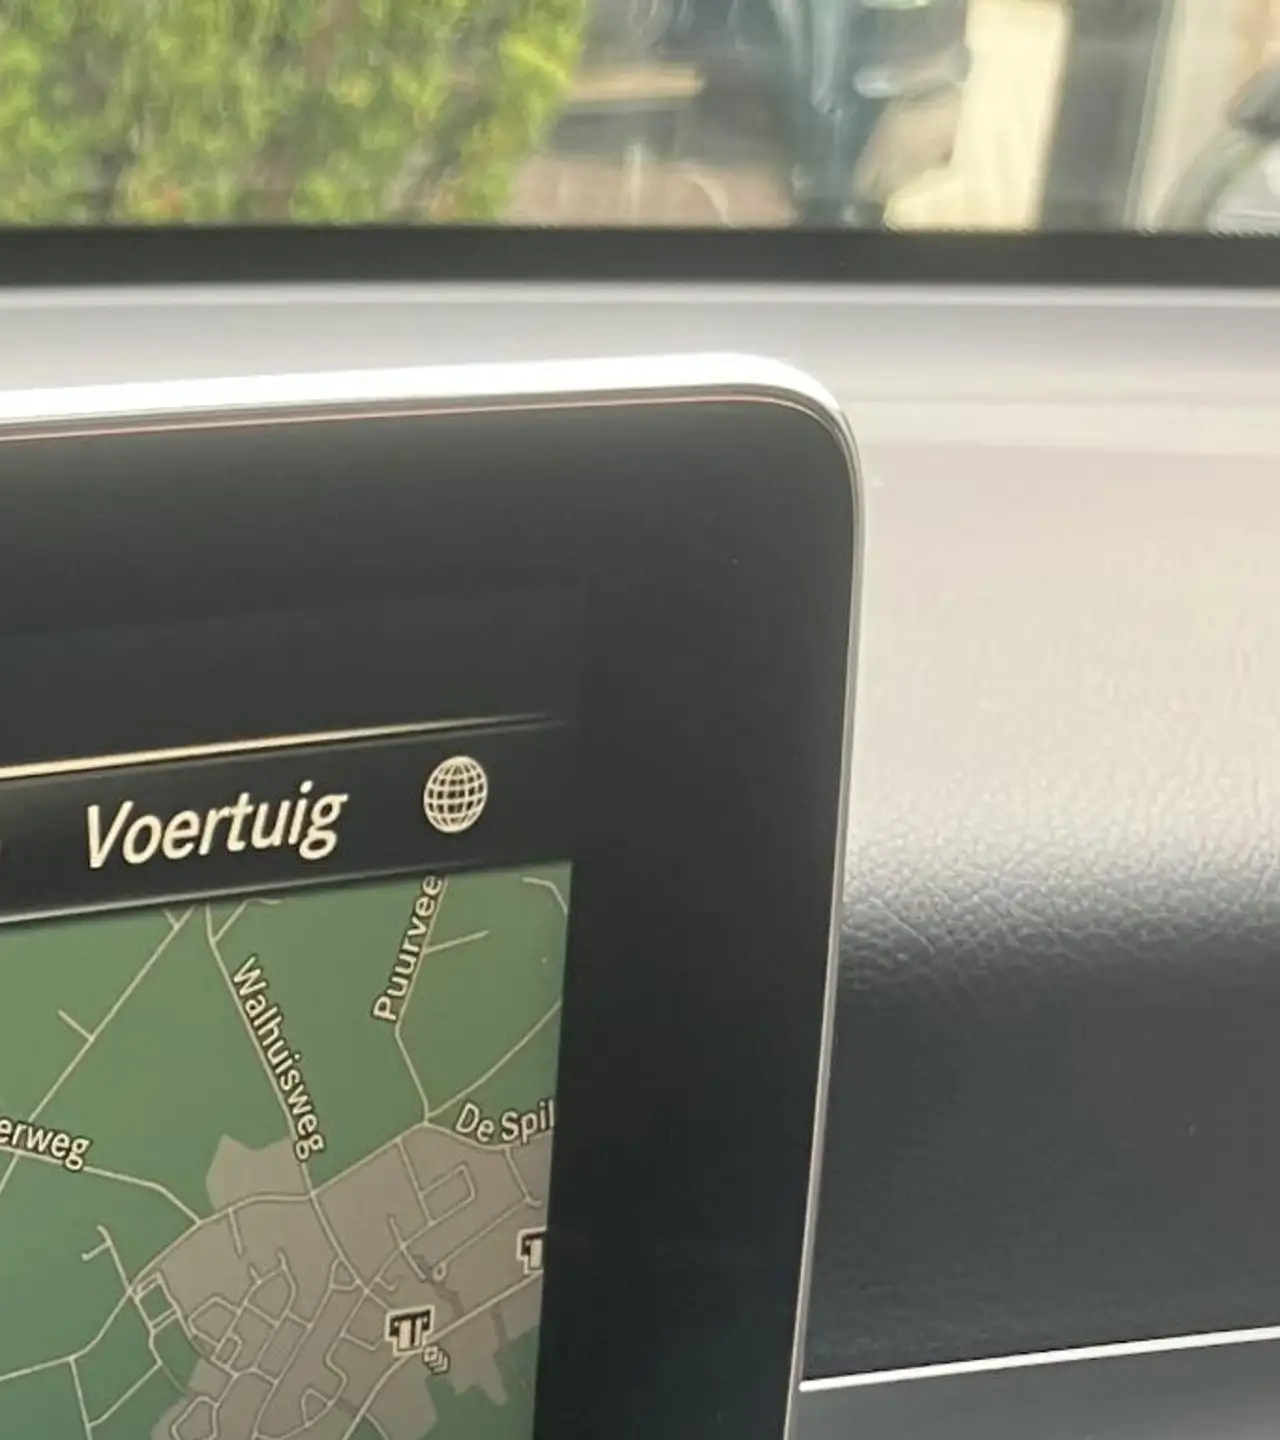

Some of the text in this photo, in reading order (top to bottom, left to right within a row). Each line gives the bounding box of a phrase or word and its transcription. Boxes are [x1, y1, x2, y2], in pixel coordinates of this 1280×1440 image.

[84, 780, 348, 864] Voertuig
[230, 954, 326, 1162] Walhuisweg
[454, 1102, 496, 1145] De
